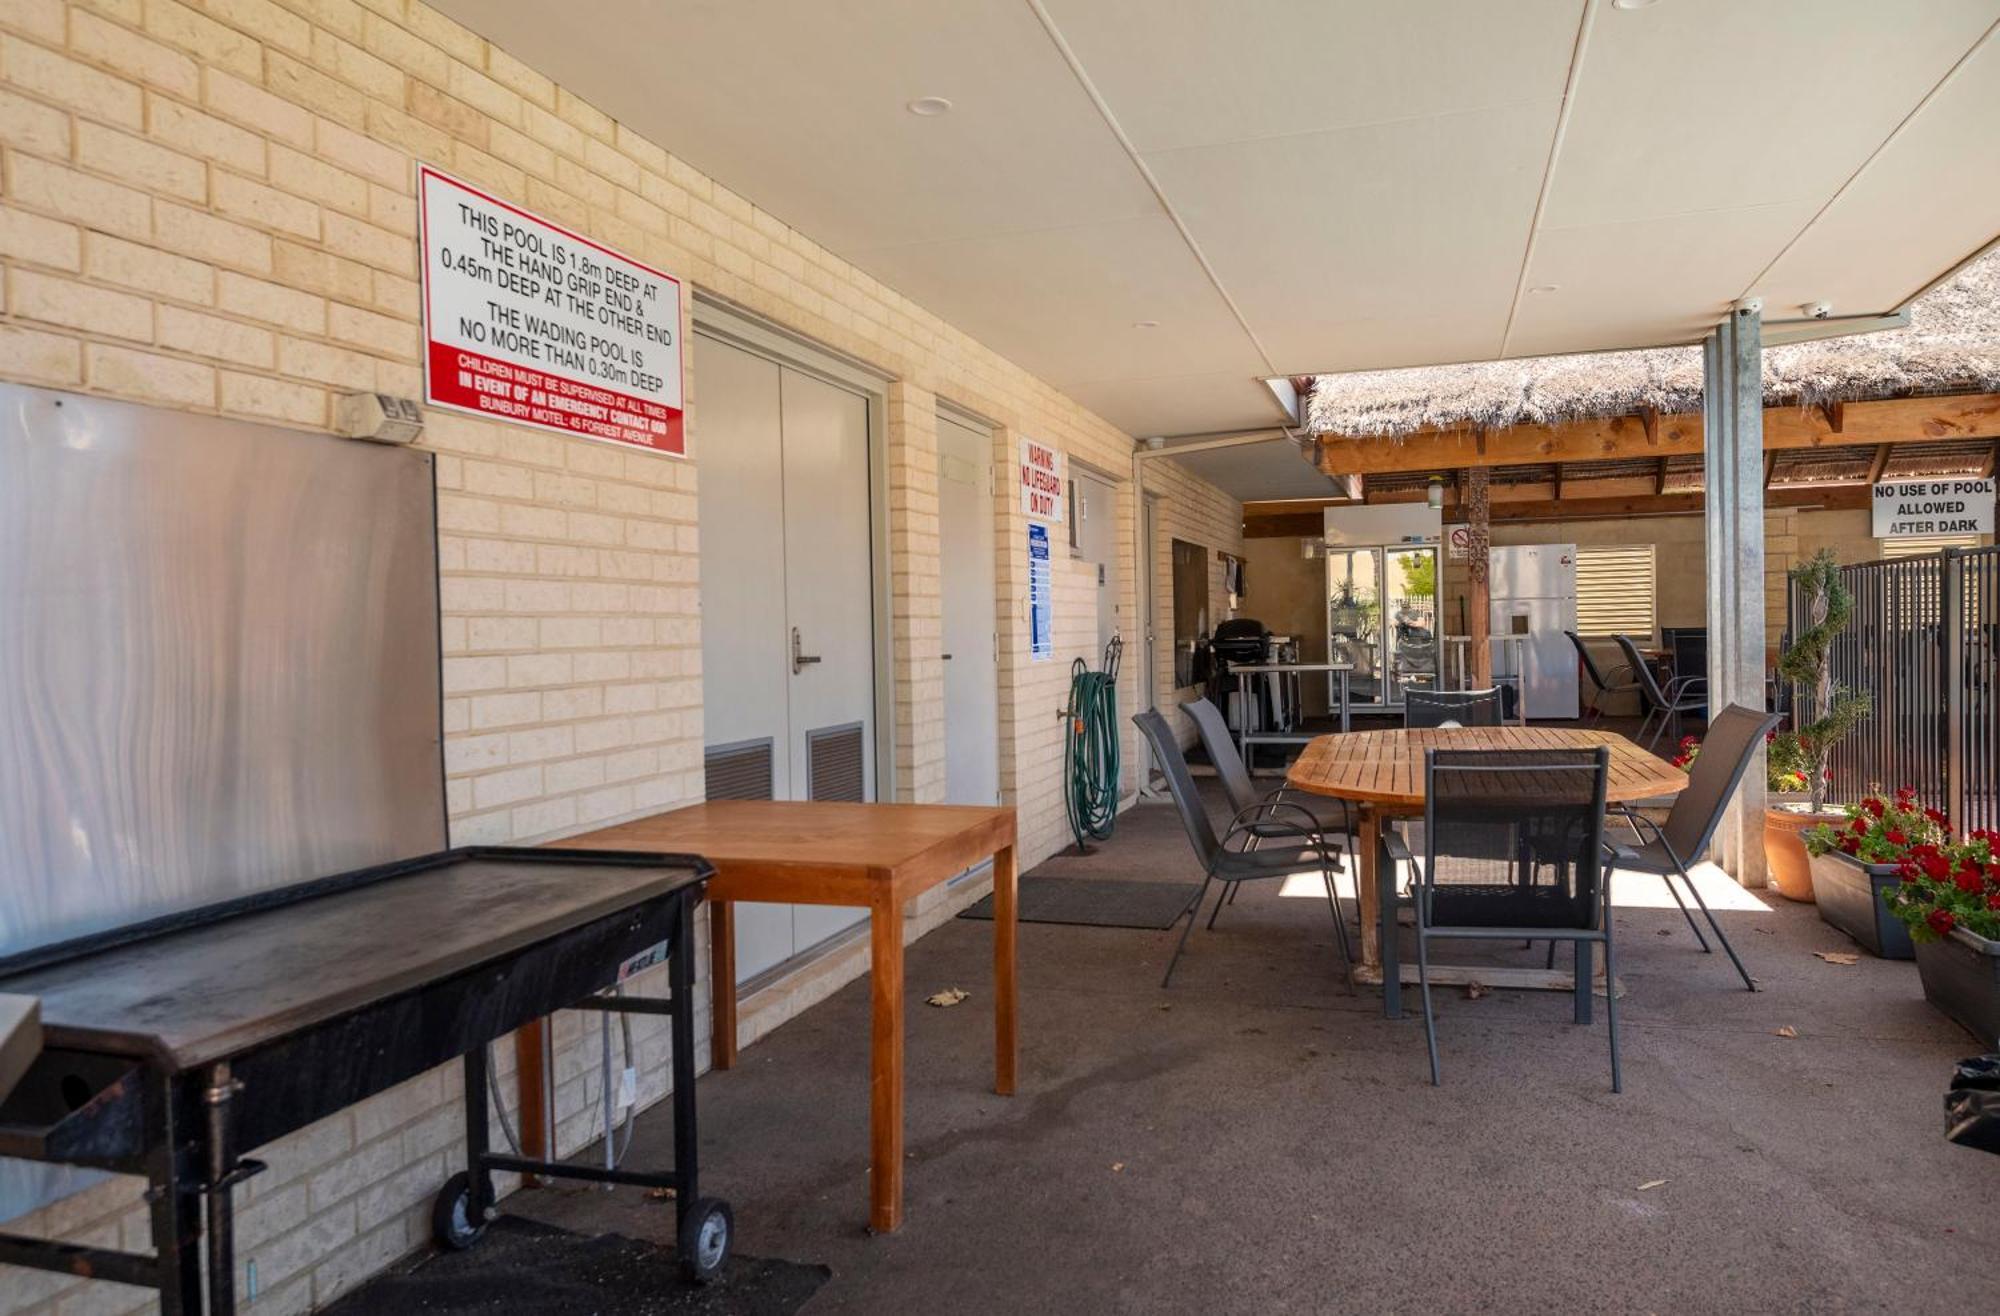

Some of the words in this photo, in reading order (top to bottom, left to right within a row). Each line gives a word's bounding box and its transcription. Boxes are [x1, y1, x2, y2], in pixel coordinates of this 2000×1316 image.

[458, 202, 498, 237] THIS
[503, 222, 548, 259] POOL
[552, 243, 566, 265] IS
[570, 253, 602, 281] 1.8m
[605, 266, 640, 293] DEEP
[643, 283, 658, 302] AT
[481, 237, 514, 268] THE
[519, 252, 563, 285] HAND
[567, 272, 601, 299] GRIP
[605, 287, 632, 312] END
[636, 299, 644, 317] &
[441, 247, 493, 284] 0.45m
[498, 268, 540, 298] DEEP
[544, 285, 562, 308] AT
[566, 294, 594, 320] THE
[598, 306, 643, 337] OTHER
[647, 323, 672, 346] END
[460, 316, 486, 342] NO
[491, 327, 541, 359] MORE
[544, 343, 584, 372] THAN
[588, 357, 627, 385] 0.30m
[631, 369, 663, 393] DEEP
[487, 300, 520, 329] THE
[524, 313, 586, 351] WADING
[591, 336, 628, 364] POOL
[631, 348, 644, 368] IS
[458, 353, 513, 380] CHILDREN
[514, 368, 543, 387] MUST
[544, 376, 559, 392] BE
[559, 381, 615, 406] SUPERVISED
[615, 395, 627, 409] AT
[627, 399, 643, 414] ALL
[643, 402, 668, 420] TIMES
[458, 370, 473, 389] IN
[474, 374, 512, 398] EVENT
[513, 385, 529, 402] OF
[531, 389, 547, 406] AN
[548, 392, 608, 421] EMERGENCY
[609, 409, 650, 431] CONTACT
[480, 394, 531, 418] BUNBURY
[582, 418, 622, 438] FORREST
[622, 428, 654, 446] AVENUE
[1023, 466, 1030, 486] NO
[1032, 467, 1060, 496] LIFEGUARD
[1028, 444, 1053, 471] WARNING
[1030, 492, 1038, 512] ON
[1040, 494, 1053, 516] DUTY
[1875, 486, 1895, 498] NO
[1900, 484, 1926, 497] USE
[1931, 483, 1949, 495] OF
[1954, 481, 1992, 494] POOL
[1897, 501, 1965, 515] ALLOWED
[1889, 521, 1934, 534] AFTER
[1938, 519, 1978, 532] DARK
